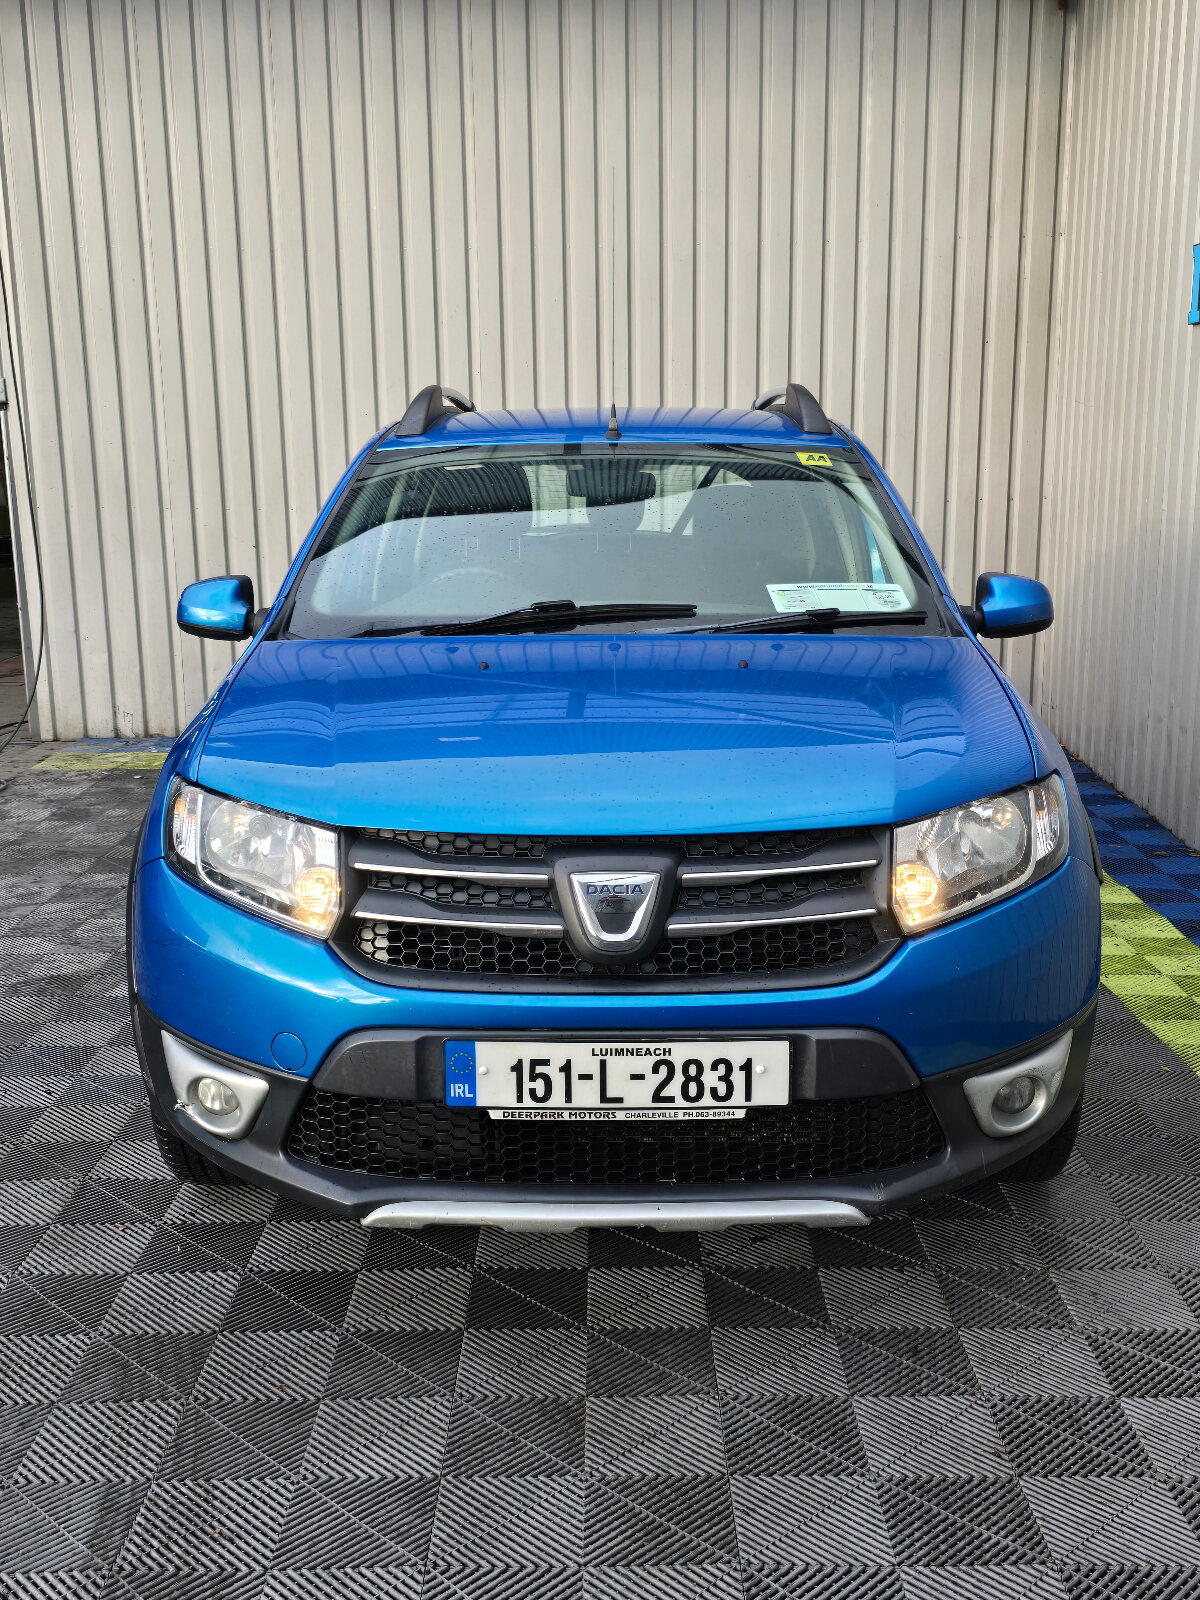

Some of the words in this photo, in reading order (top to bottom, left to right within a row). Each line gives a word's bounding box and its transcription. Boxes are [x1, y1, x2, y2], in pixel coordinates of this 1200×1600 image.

[805, 454, 828, 463] AA
[586, 884, 645, 895] DACIA
[591, 1047, 672, 1057] LUIMNEACH
[510, 1057, 753, 1104] 151-L-2831
[450, 1083, 474, 1098] IRL
[502, 1111, 565, 1120] DEERPARK
[568, 1111, 617, 1119] MOTORS
[624, 1111, 679, 1119] CHARLEVILLE
